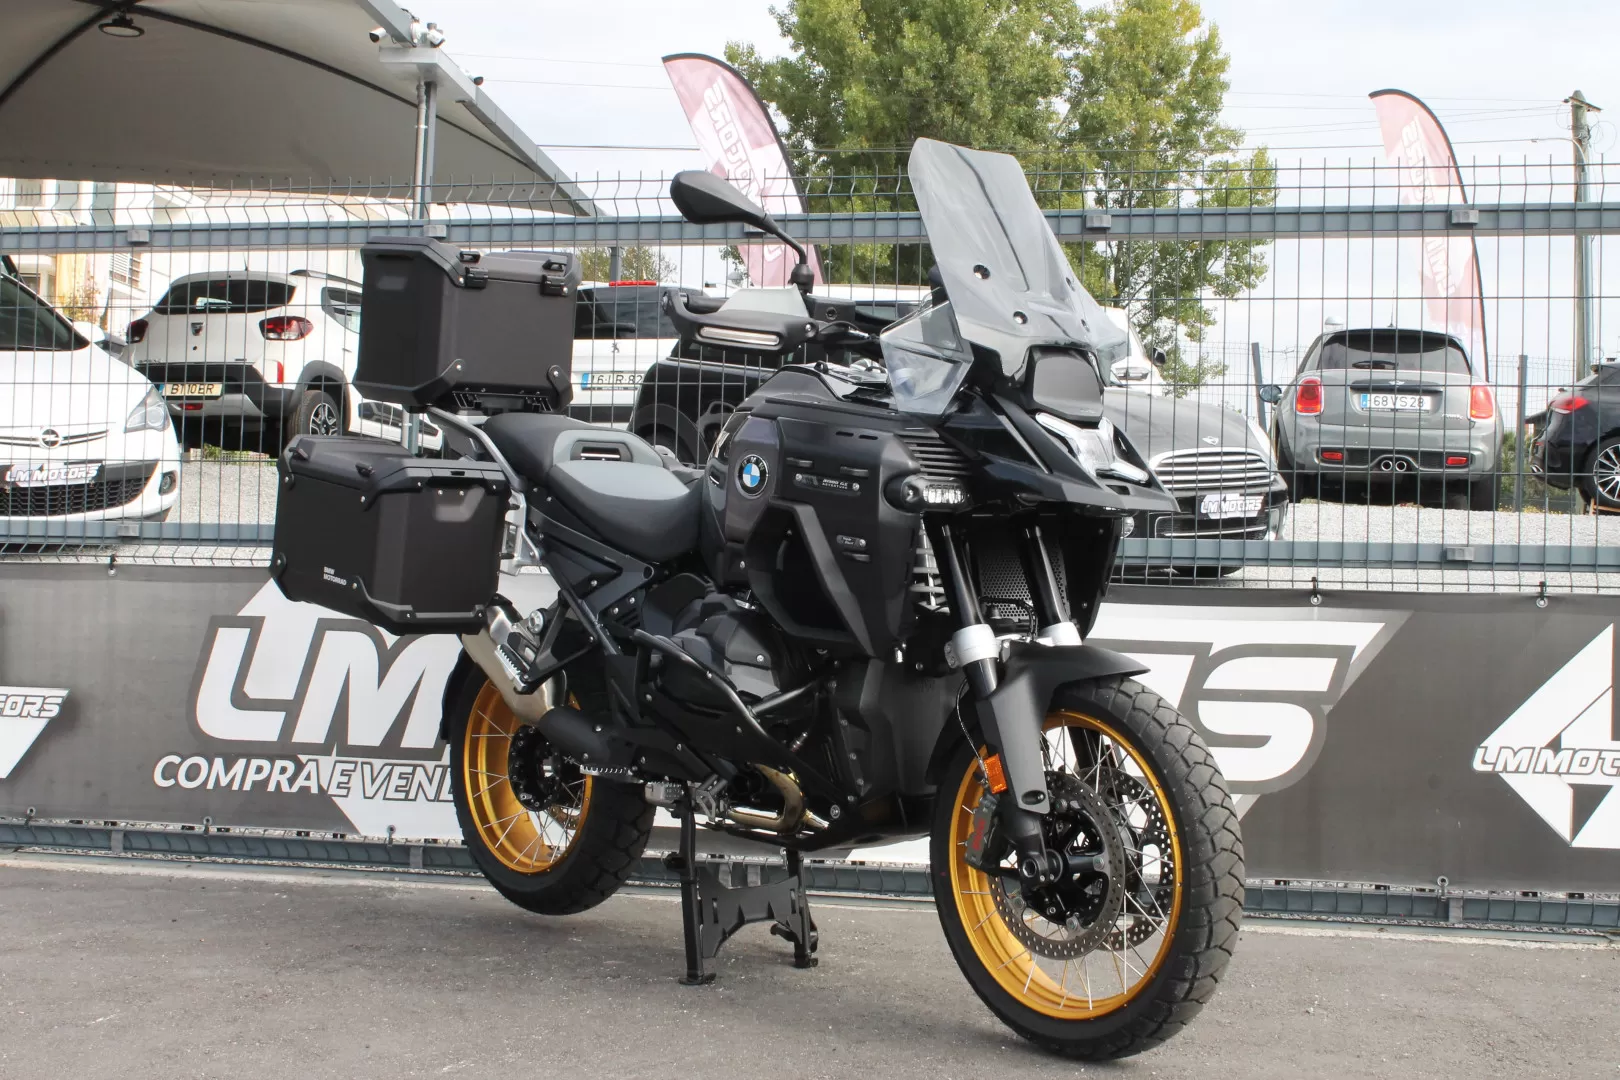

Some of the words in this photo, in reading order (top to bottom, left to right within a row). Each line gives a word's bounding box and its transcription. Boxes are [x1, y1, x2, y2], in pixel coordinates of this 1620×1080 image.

[153, 754, 319, 794] COMPRA
[327, 759, 358, 797] E
[1472, 746, 1536, 774] LM
